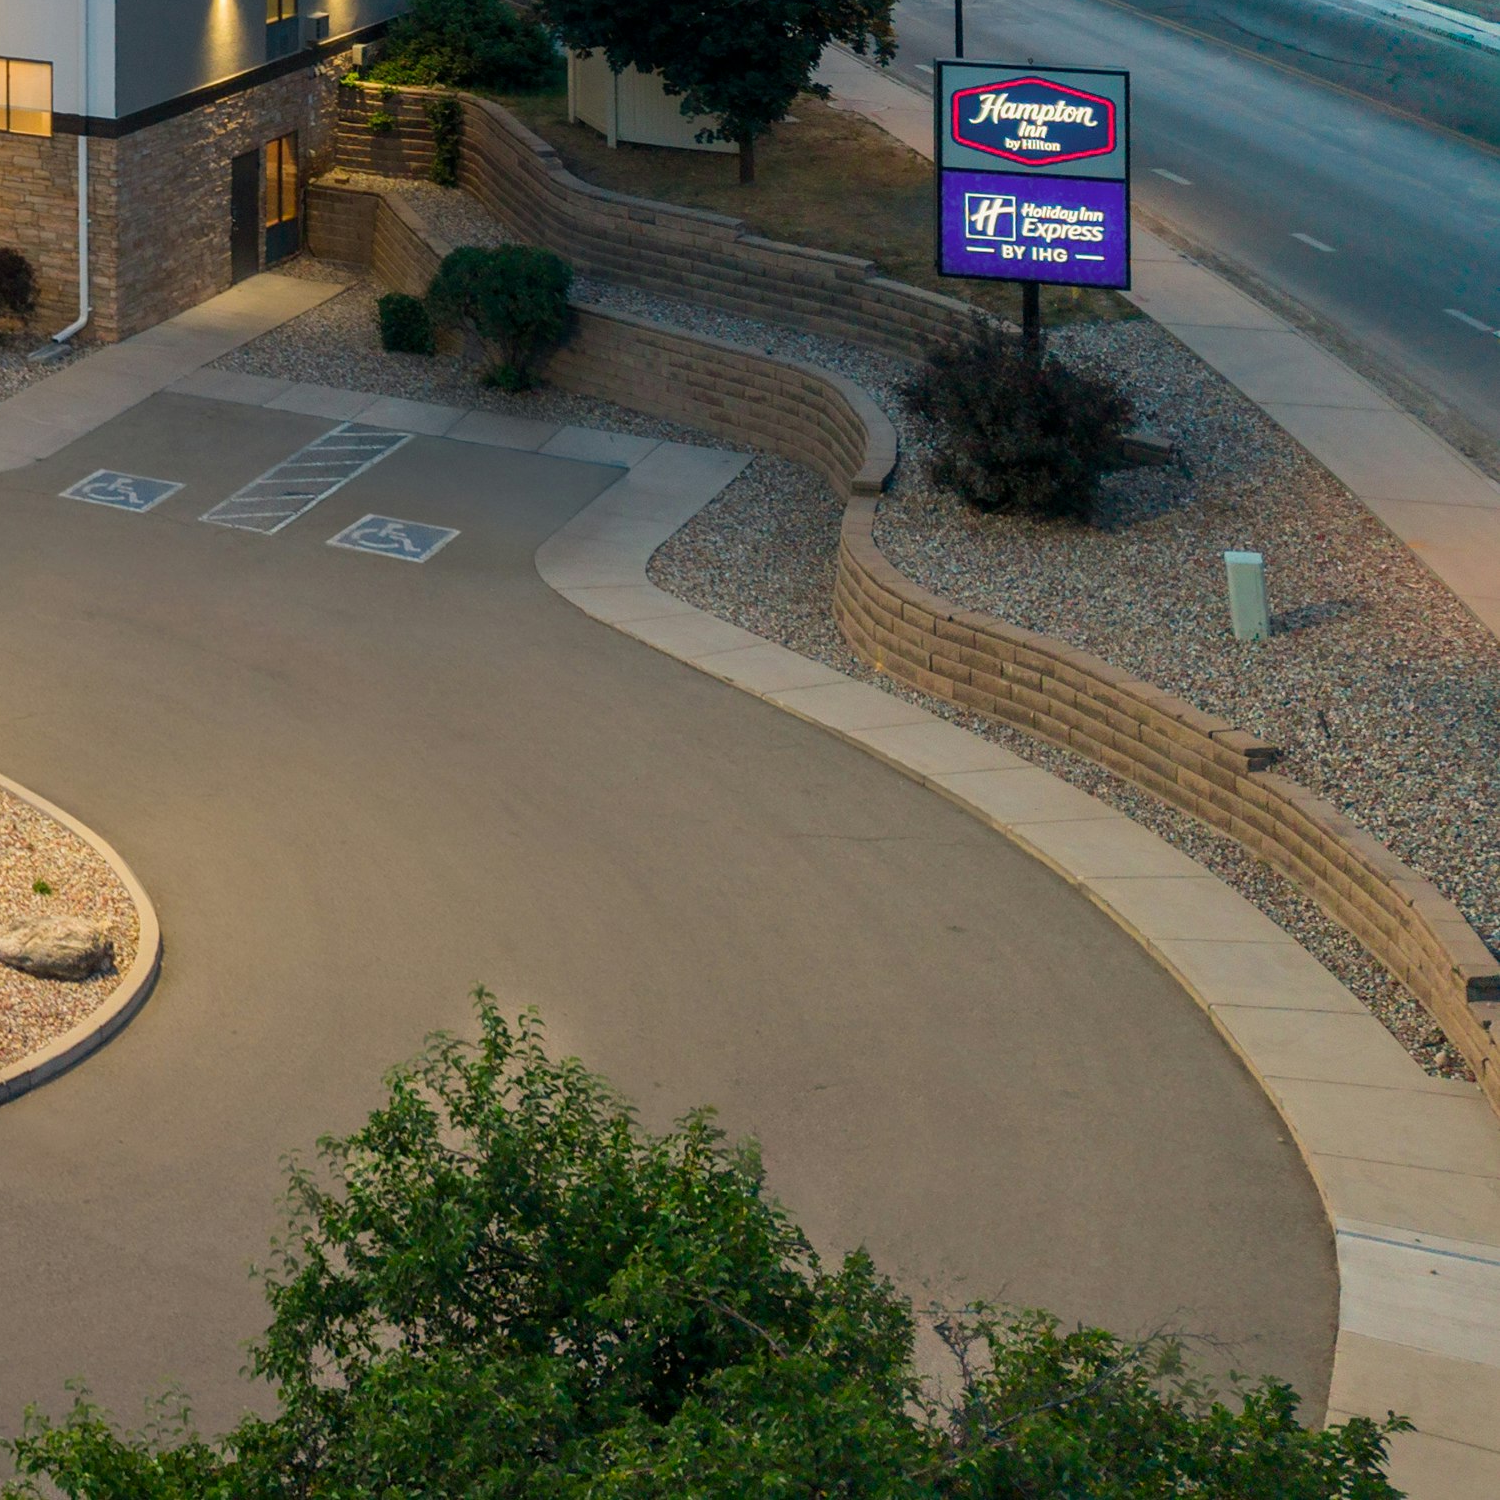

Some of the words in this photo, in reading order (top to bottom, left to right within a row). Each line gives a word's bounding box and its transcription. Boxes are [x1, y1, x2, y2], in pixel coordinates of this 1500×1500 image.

[968, 93, 1098, 127] Hampton
[1018, 121, 1048, 138] Inn
[1005, 137, 1021, 151] by
[1022, 139, 1061, 152] Hilton
[1021, 203, 1079, 223] Holiday
[1080, 207, 1104, 222] Inn
[1021, 218, 1105, 242] Express
[1002, 245, 1026, 260] BY
[1032, 247, 1068, 263] IHG
